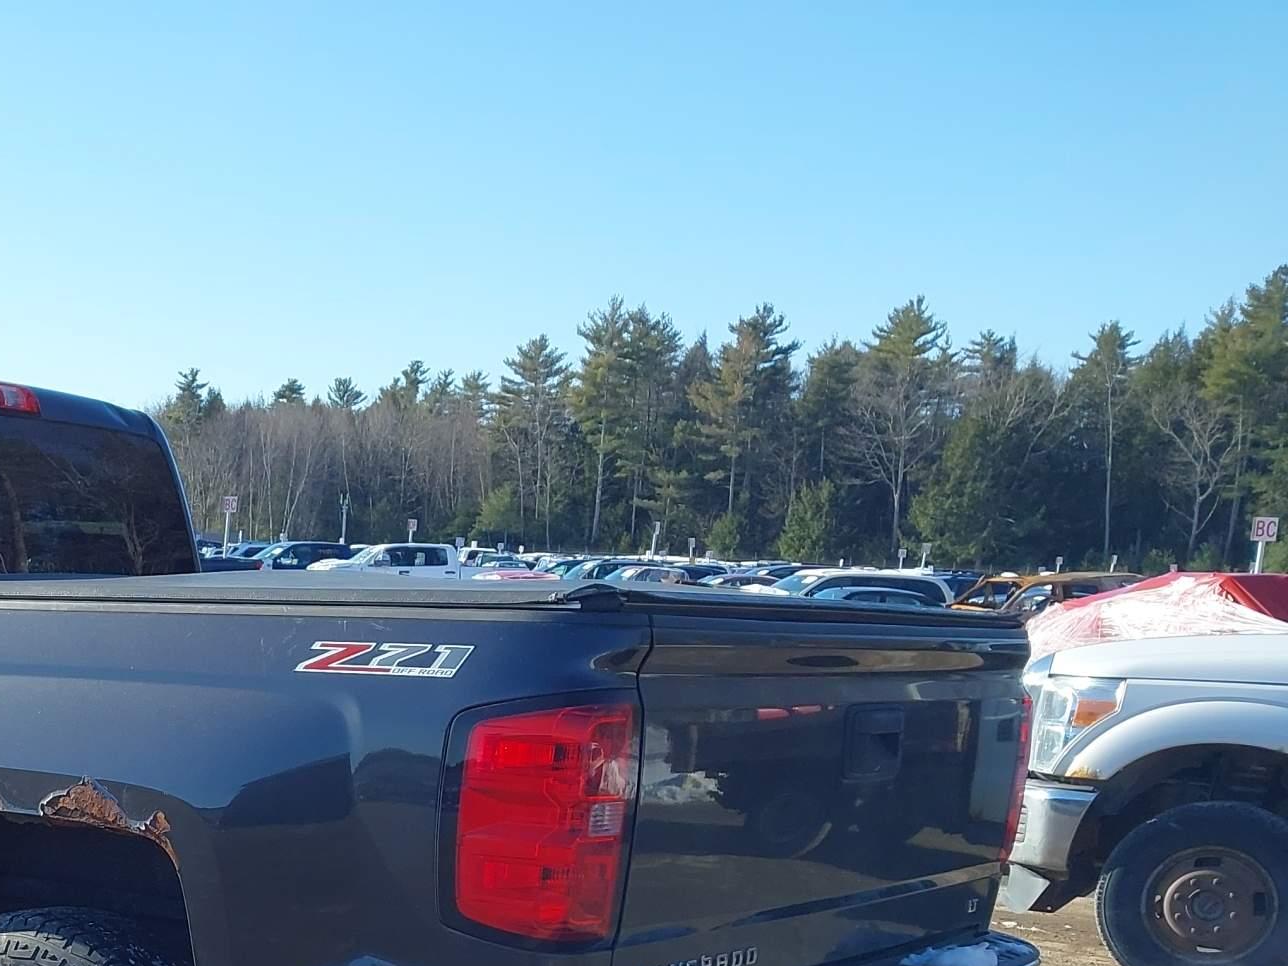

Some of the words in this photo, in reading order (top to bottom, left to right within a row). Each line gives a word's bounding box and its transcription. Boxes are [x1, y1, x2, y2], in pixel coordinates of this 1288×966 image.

[1255, 520, 1277, 538] BC
[294, 641, 475, 676] Z71
[419, 668, 454, 677] ROAD
